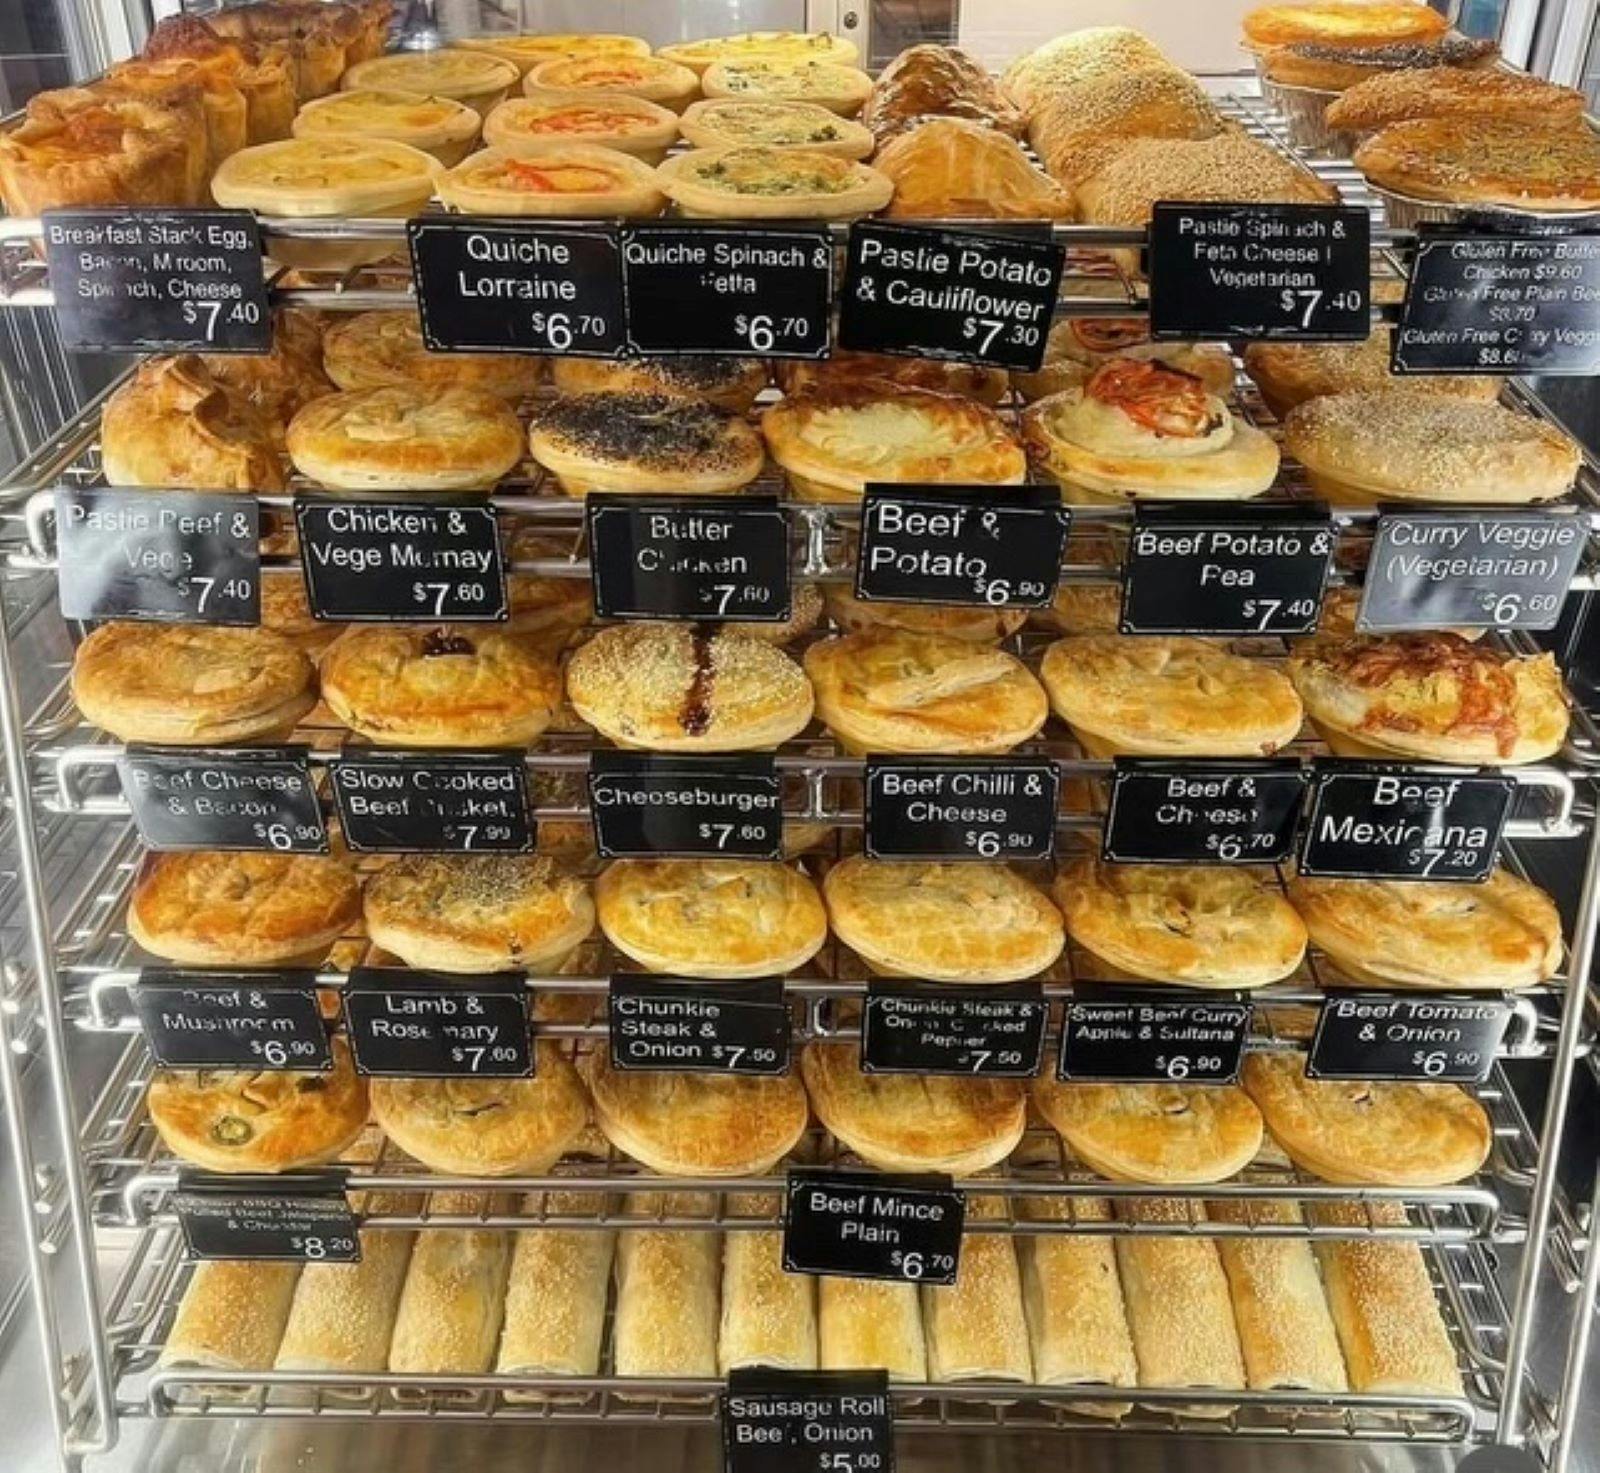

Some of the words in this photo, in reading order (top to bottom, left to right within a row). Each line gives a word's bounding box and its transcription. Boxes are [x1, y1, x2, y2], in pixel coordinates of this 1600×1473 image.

[50, 225, 142, 245] Breakfast
[147, 225, 205, 244] Stack
[208, 225, 254, 251] Egg,
[1179, 217, 1240, 236] Pastie
[1331, 220, 1347, 239] &
[466, 234, 571, 264] Quiche
[626, 243, 707, 265] Quiche
[714, 243, 806, 269] Spinach
[811, 248, 829, 270] &
[1244, 243, 1320, 262] Cheese
[860, 239, 950, 274] Pastie
[960, 250, 1053, 287] Potato
[168, 278, 242, 299] Cheese
[459, 270, 576, 300] Lorraine
[1209, 267, 1317, 289] Vegetarian
[856, 275, 877, 302] &
[886, 279, 1045, 321] Cauliflower
[1280, 289, 1361, 329] $7.40
[183, 300, 259, 342] $7.40
[532, 311, 606, 350] $6.70
[735, 313, 809, 351] $6.70
[963, 317, 1040, 356] $7.30
[65, 504, 150, 531] Pastie
[230, 511, 252, 539] &
[327, 508, 438, 534] Chicken
[446, 509, 468, 536] &
[651, 514, 736, 541] Butter
[878, 503, 969, 539] Beef
[1137, 531, 1207, 556] Beef
[1209, 531, 1302, 556] Potato
[1308, 531, 1329, 556] &
[1390, 522, 1469, 550] Curry
[1479, 521, 1576, 551] Veggie
[310, 542, 383, 573] Vege
[870, 546, 988, 579] Potato
[1386, 554, 1559, 583] (Vegetarian)
[1199, 564, 1257, 587] Pea
[178, 577, 252, 614] $7.40
[1242, 598, 1316, 632] $7.40
[201, 770, 302, 791] Cheese
[340, 768, 404, 790] Slow
[882, 773, 945, 796] Beef
[952, 773, 1014, 796] Chilli
[1022, 773, 1042, 797] &
[1166, 776, 1233, 798] Beef
[1236, 776, 1257, 798] &
[1372, 776, 1462, 808] Beef
[168, 796, 187, 816] &
[350, 796, 409, 816] Beef
[594, 786, 780, 812] Cheeseburger
[906, 801, 1008, 823] Cheese
[965, 831, 1034, 858] $6.90
[1204, 833, 1276, 862] $6.70
[1409, 846, 1478, 878] $7.20
[249, 990, 269, 1009] &
[384, 994, 458, 1015] Lamb
[466, 994, 486, 1015] &
[616, 998, 721, 1019] Chunkie
[1018, 1003, 1033, 1018] &
[1336, 1000, 1399, 1018] Beef
[1408, 1001, 1499, 1020] Tomato
[621, 1019, 693, 1037] Steak
[698, 1022, 718, 1039] &
[1070, 1006, 1135, 1022] Sweet
[1191, 1009, 1247, 1028] Curry
[1138, 1025, 1152, 1041] &
[1159, 1026, 1236, 1042] Sultana
[1358, 1022, 1377, 1041] &
[1386, 1023, 1462, 1043] Onion
[628, 1040, 702, 1058] Onion
[809, 1192, 867, 1214] Beef
[872, 1196, 946, 1222] Mince
[840, 1220, 901, 1244] Plain
[890, 1250, 955, 1280] $6.70
[728, 1397, 834, 1421] Sausage
[840, 1396, 886, 1417] Roll
[735, 1422, 799, 1446] Bee,
[802, 1421, 874, 1444] Onion
